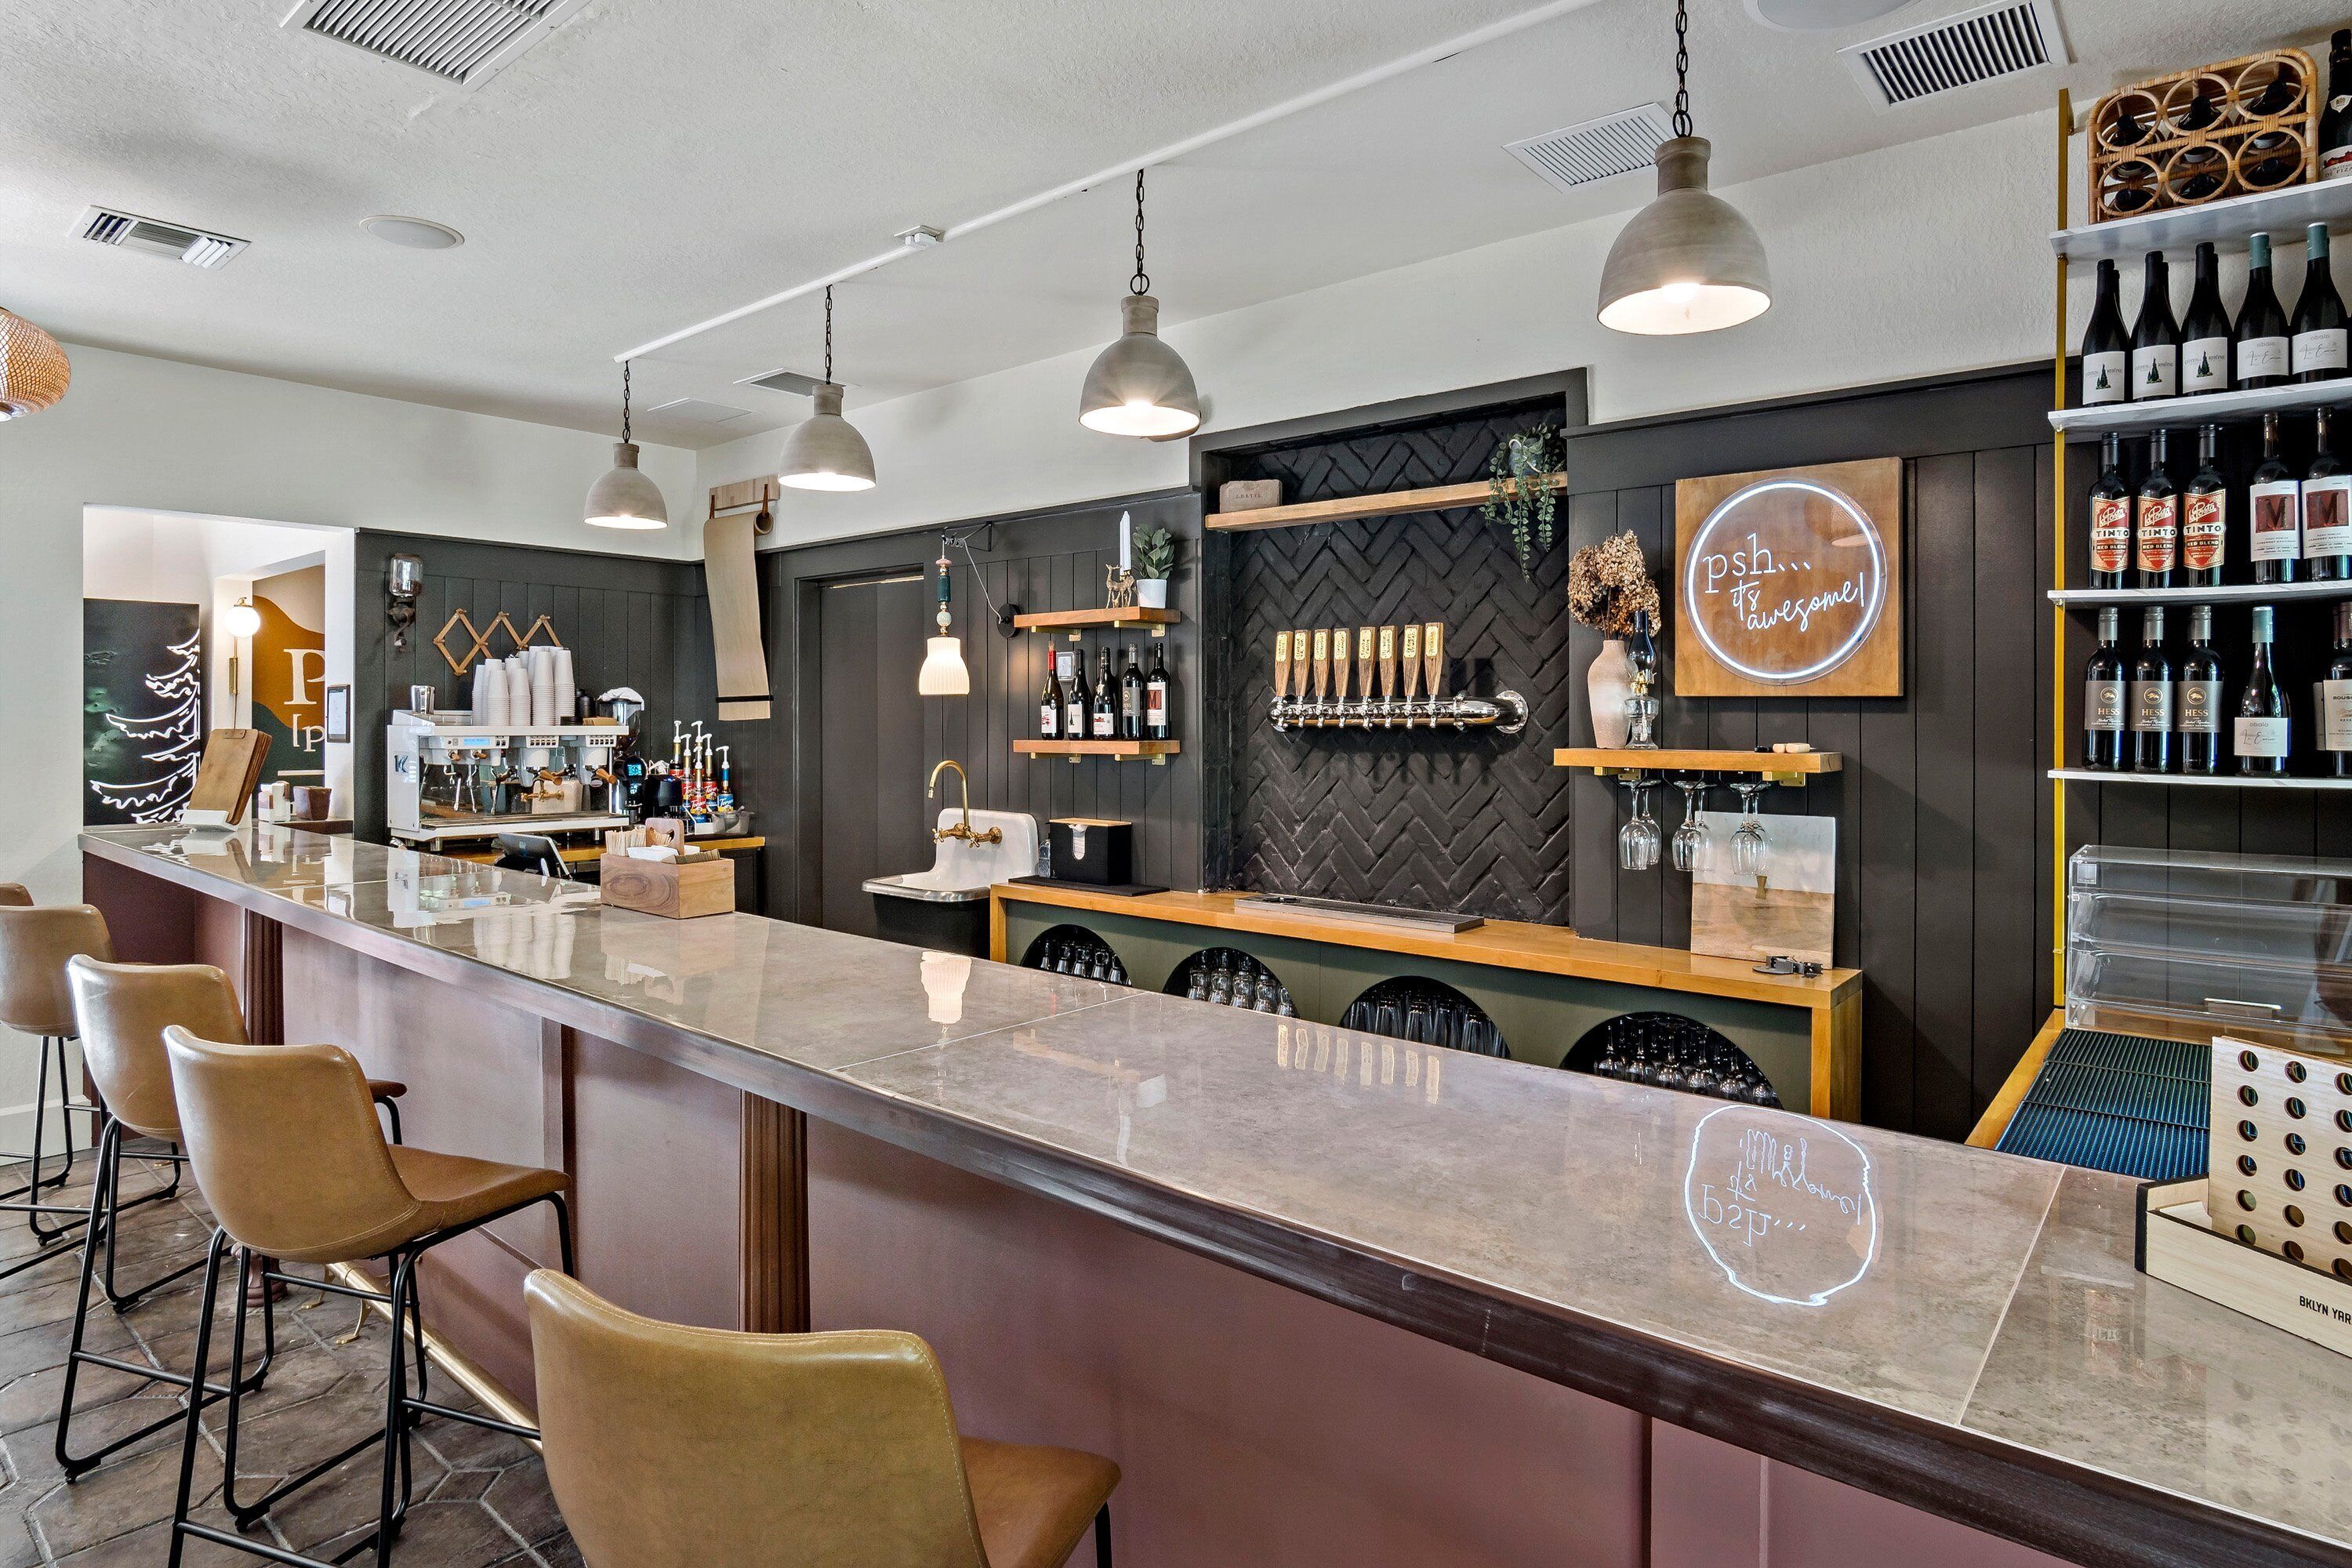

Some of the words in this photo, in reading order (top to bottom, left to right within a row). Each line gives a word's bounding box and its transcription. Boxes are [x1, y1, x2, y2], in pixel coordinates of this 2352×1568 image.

[2141, 528, 2176, 537] TINTO
[2186, 524, 2221, 534] TINTO
[1701, 532, 1812, 594] psh...
[1730, 579, 1760, 622] it's
[1747, 571, 1865, 633] awesome!
[2097, 707, 2121, 716] HESS
[2141, 708, 2165, 717] HESS
[2299, 1294, 2328, 1316] BKLYN
[2332, 1306, 2352, 1325] YAR
